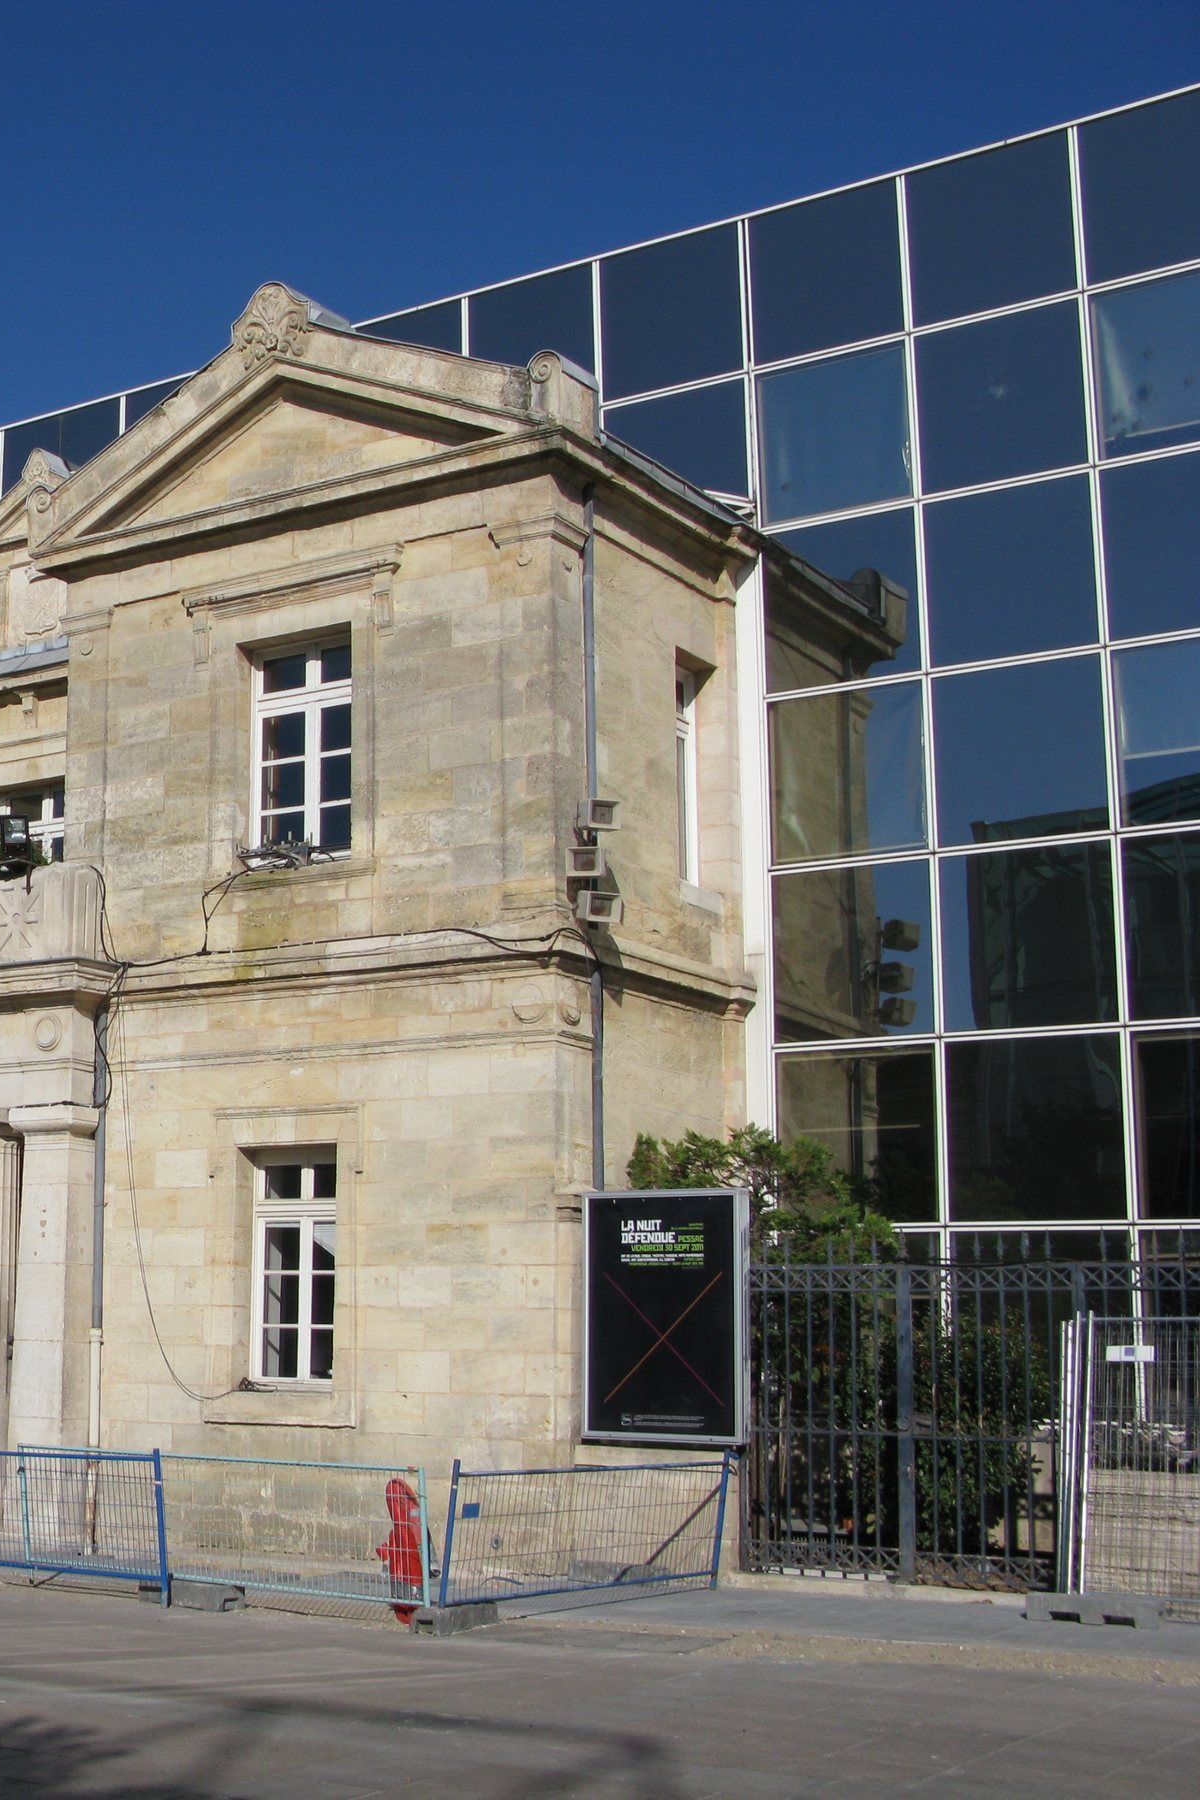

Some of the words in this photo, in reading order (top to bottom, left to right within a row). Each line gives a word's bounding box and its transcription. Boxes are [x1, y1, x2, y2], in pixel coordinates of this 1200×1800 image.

[621, 1220, 634, 1231] LA
[637, 1220, 662, 1231] NUIT
[621, 1231, 675, 1244] DÉFENDUE
[678, 1235, 704, 1243] PESSAC
[691, 1243, 704, 1251] 2011
